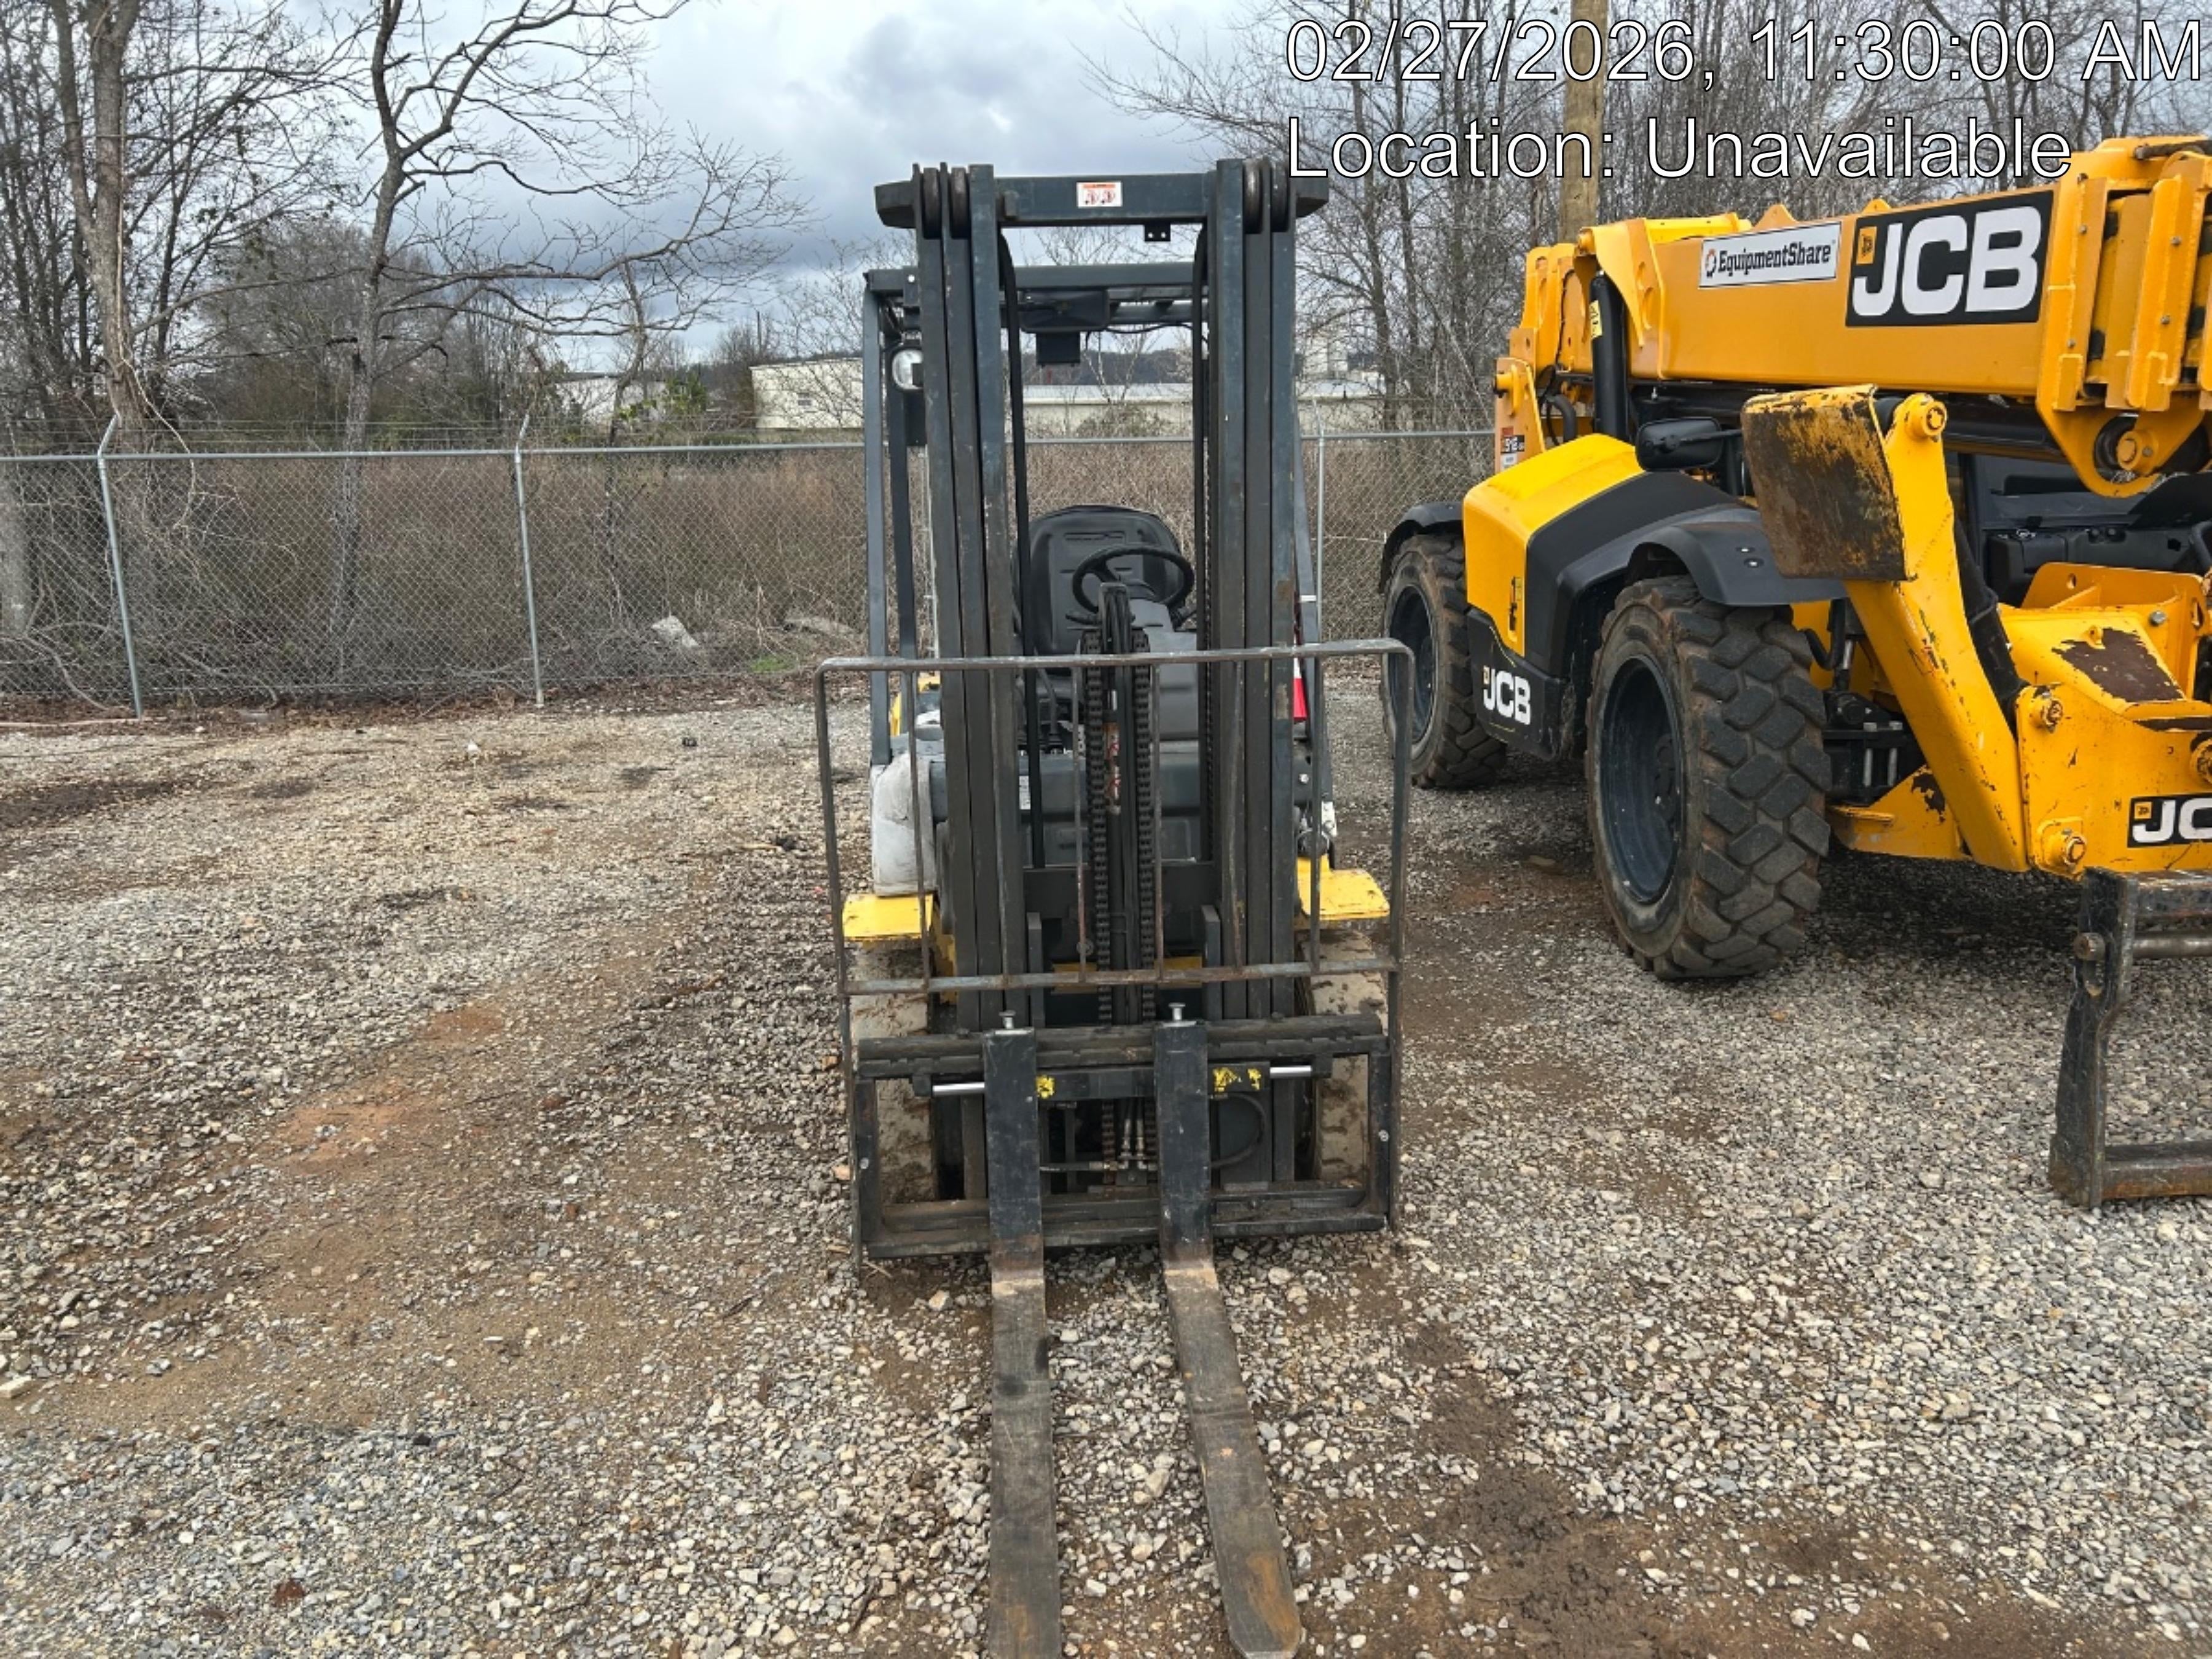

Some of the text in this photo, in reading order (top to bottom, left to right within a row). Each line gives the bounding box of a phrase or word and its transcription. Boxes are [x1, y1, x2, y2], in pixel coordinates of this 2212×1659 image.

[1718, 241, 1832, 277] EquipmentShare
[1853, 206, 2041, 316] JCB
[1483, 668, 1531, 725] JCB
